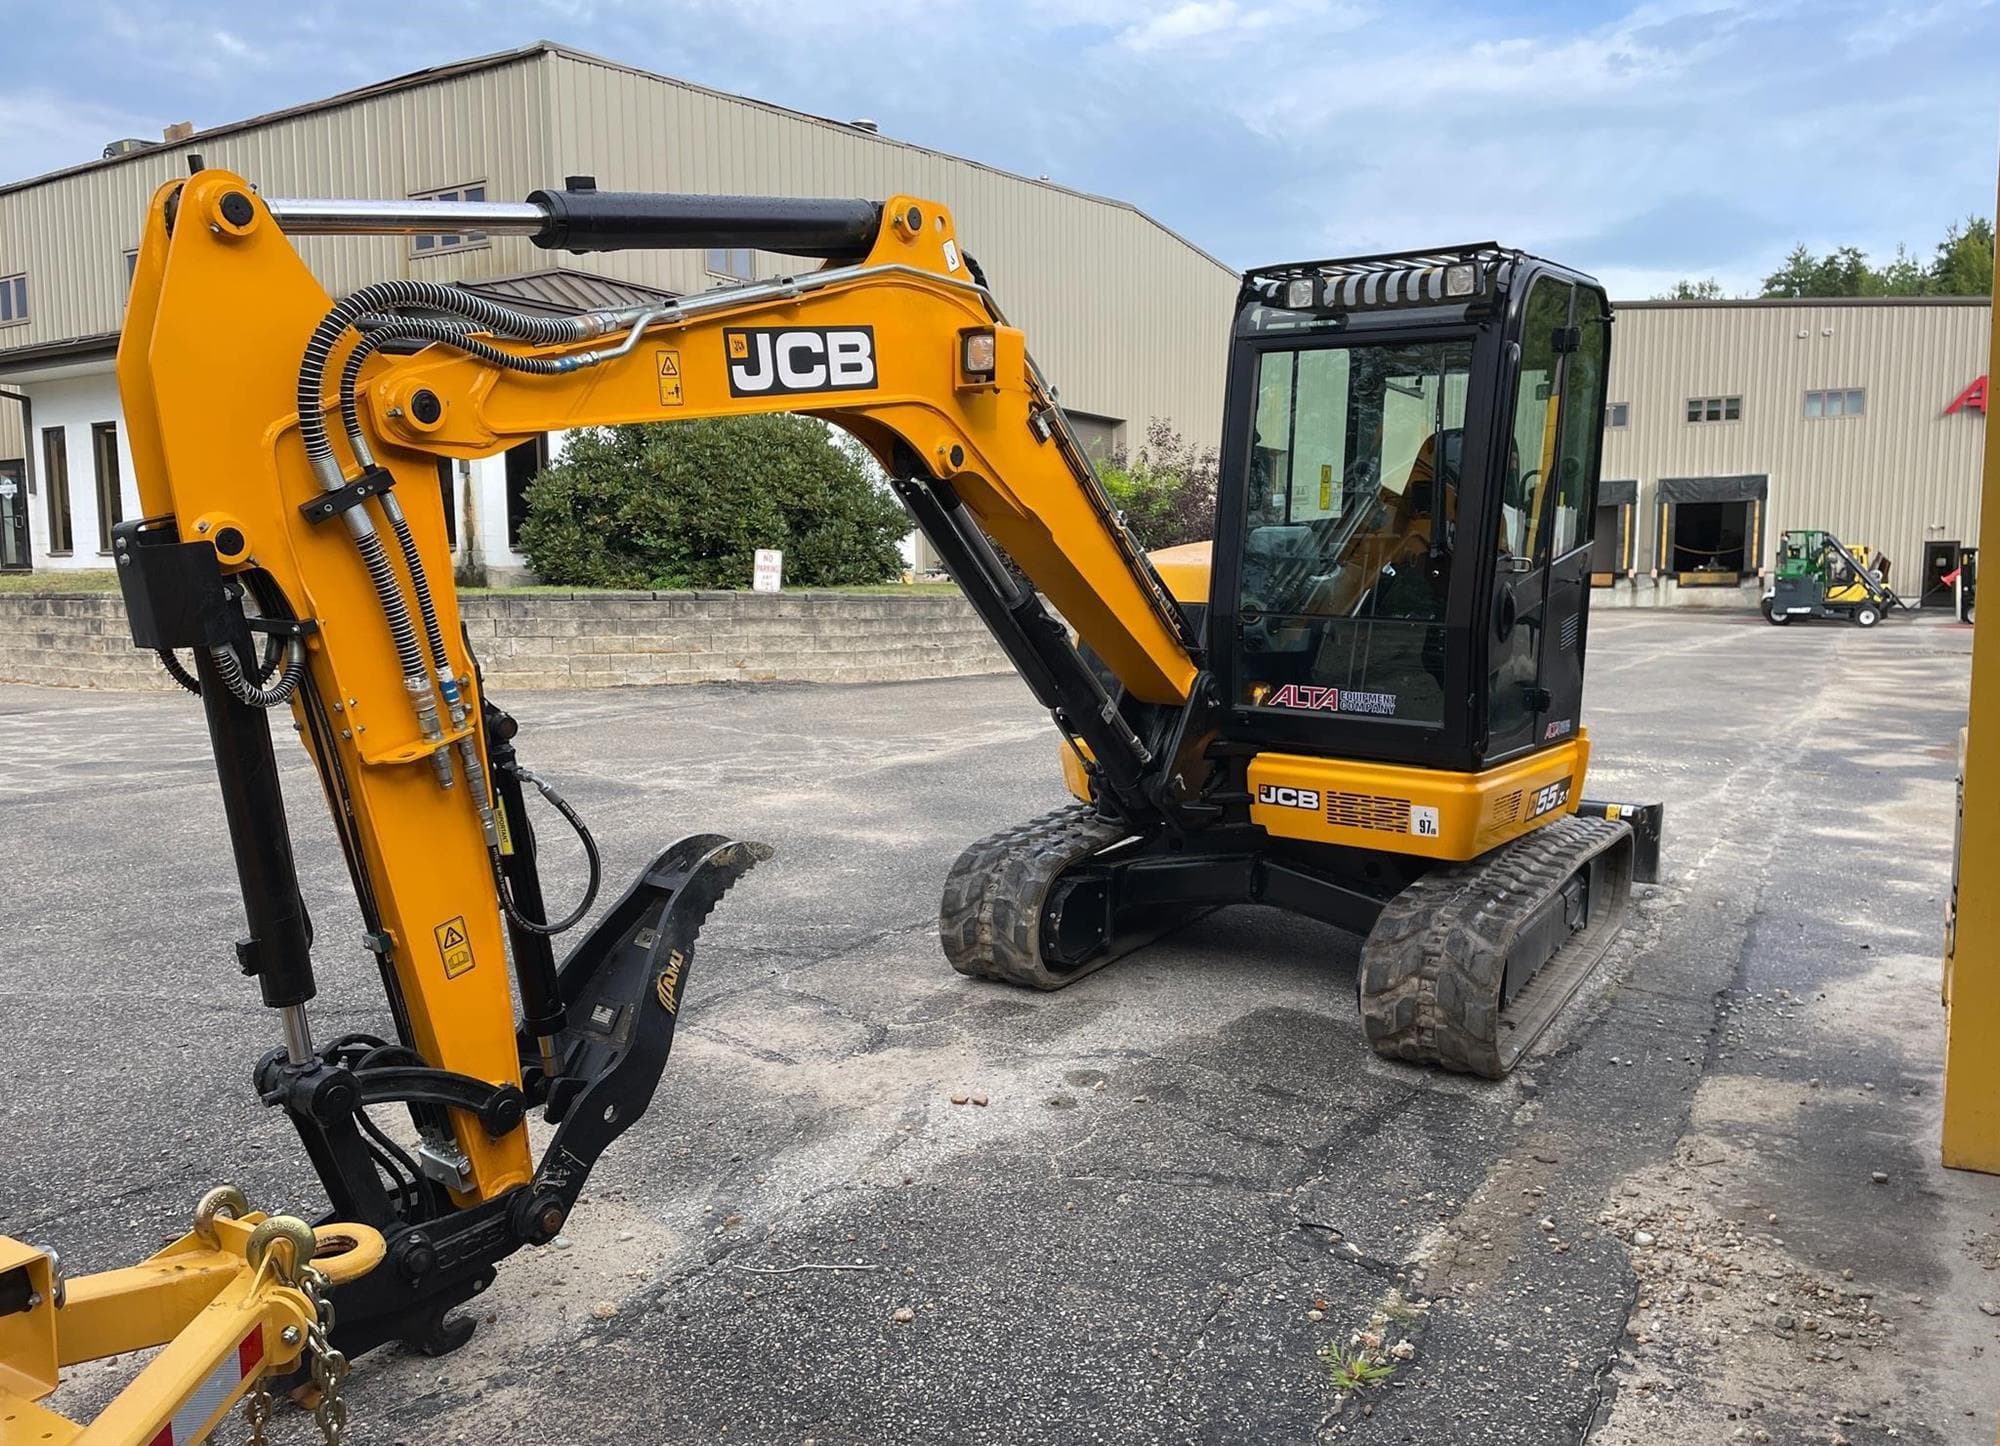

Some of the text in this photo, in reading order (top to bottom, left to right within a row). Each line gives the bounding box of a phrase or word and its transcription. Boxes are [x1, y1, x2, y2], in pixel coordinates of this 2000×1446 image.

[731, 331, 875, 391] JCB
[1268, 684, 1339, 711] ALTA
[1340, 690, 1397, 705] EQUIPMENT
[1340, 701, 1396, 715] COMPANY
[1260, 786, 1320, 810] JCB
[1419, 819, 1432, 834] 97
